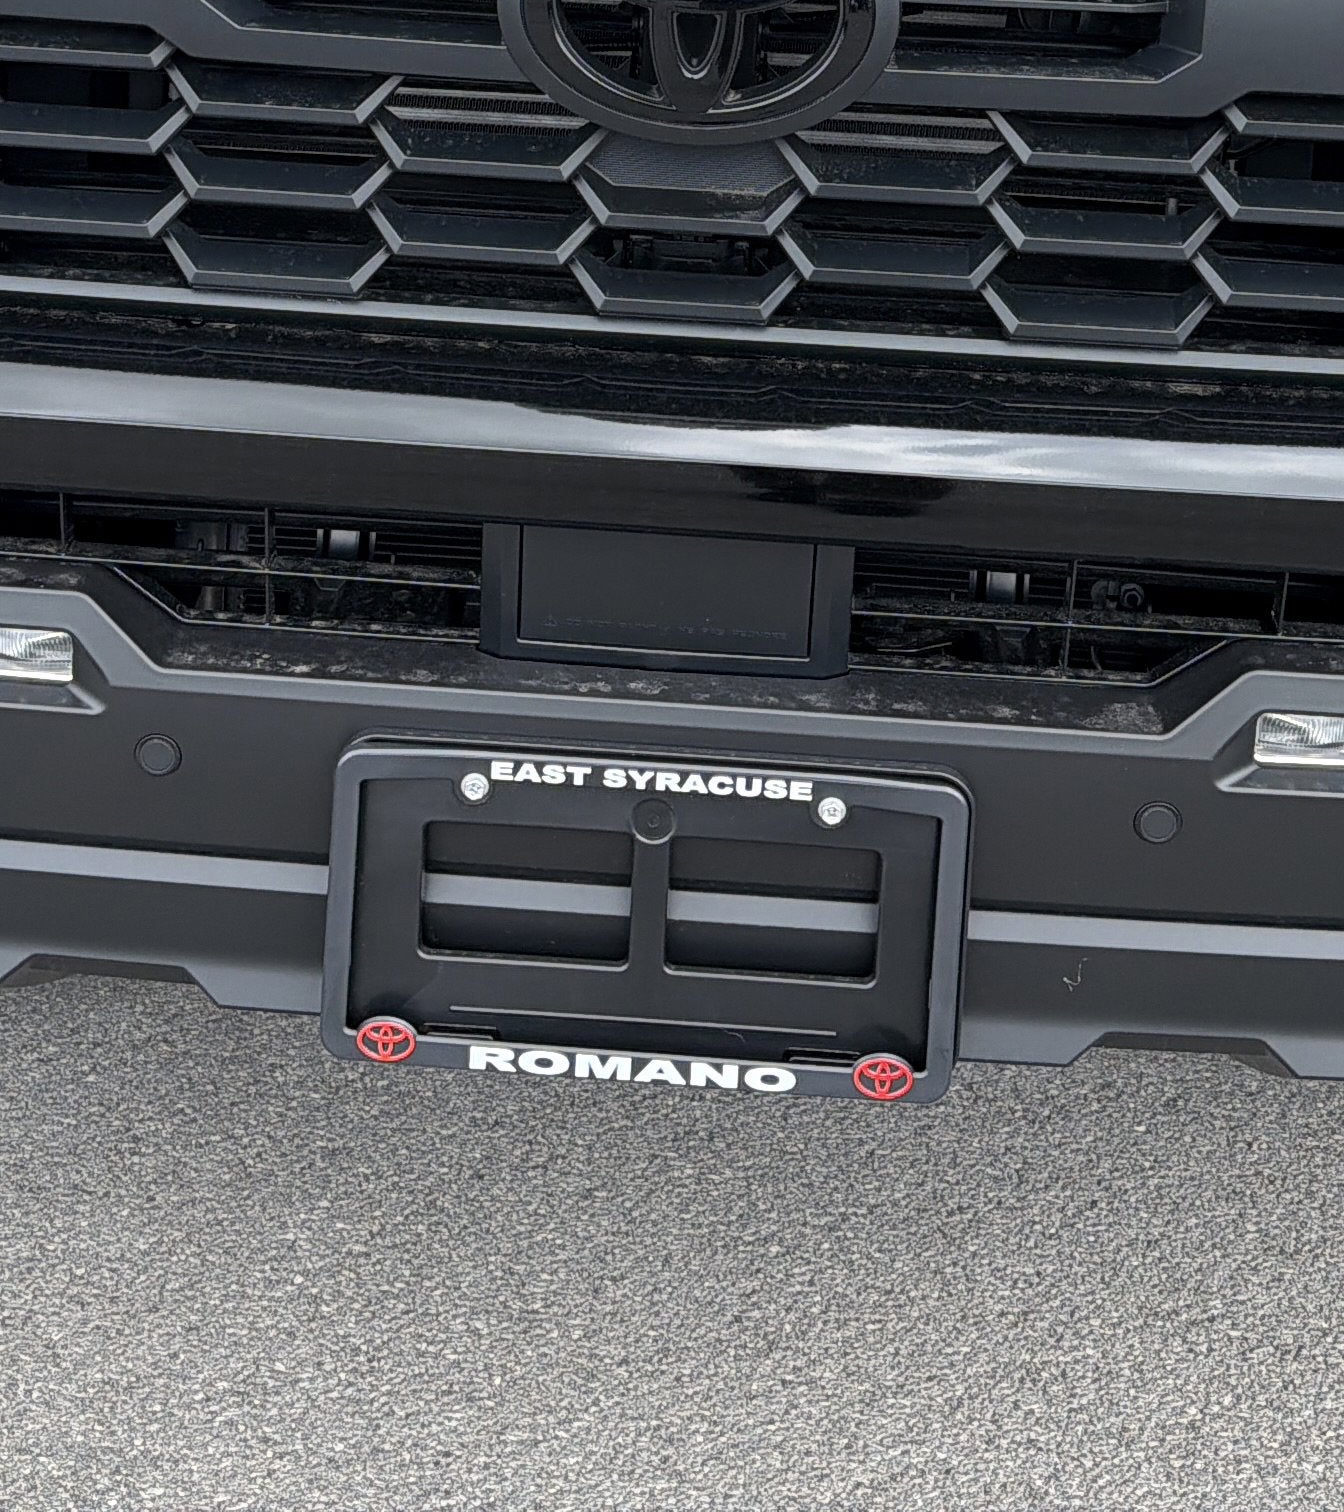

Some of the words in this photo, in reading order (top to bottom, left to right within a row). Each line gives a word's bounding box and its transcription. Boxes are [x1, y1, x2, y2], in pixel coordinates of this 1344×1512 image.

[490, 760, 592, 787] EAST
[602, 768, 814, 802] SYRACUSE
[468, 1045, 797, 1092] ROMANO
